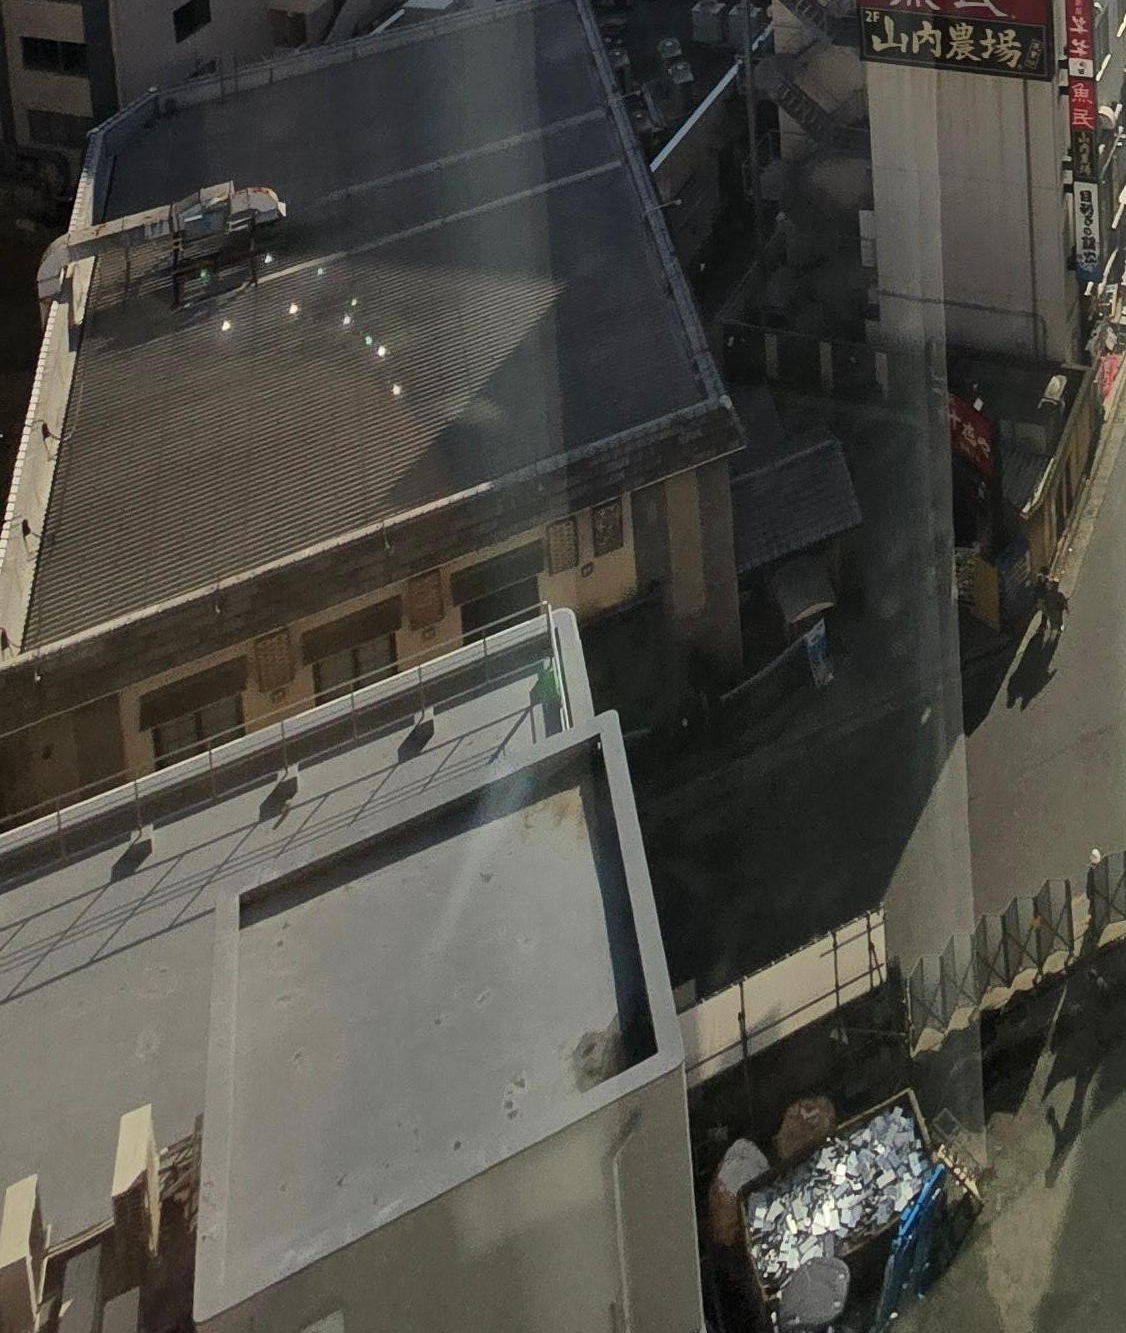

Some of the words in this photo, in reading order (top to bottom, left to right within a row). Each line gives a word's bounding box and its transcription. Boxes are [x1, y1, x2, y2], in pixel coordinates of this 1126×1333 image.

[865, 10, 880, 23] 2F
[871, 15, 1023, 68] 山内農場
[1071, 82, 1094, 130] 魚民
